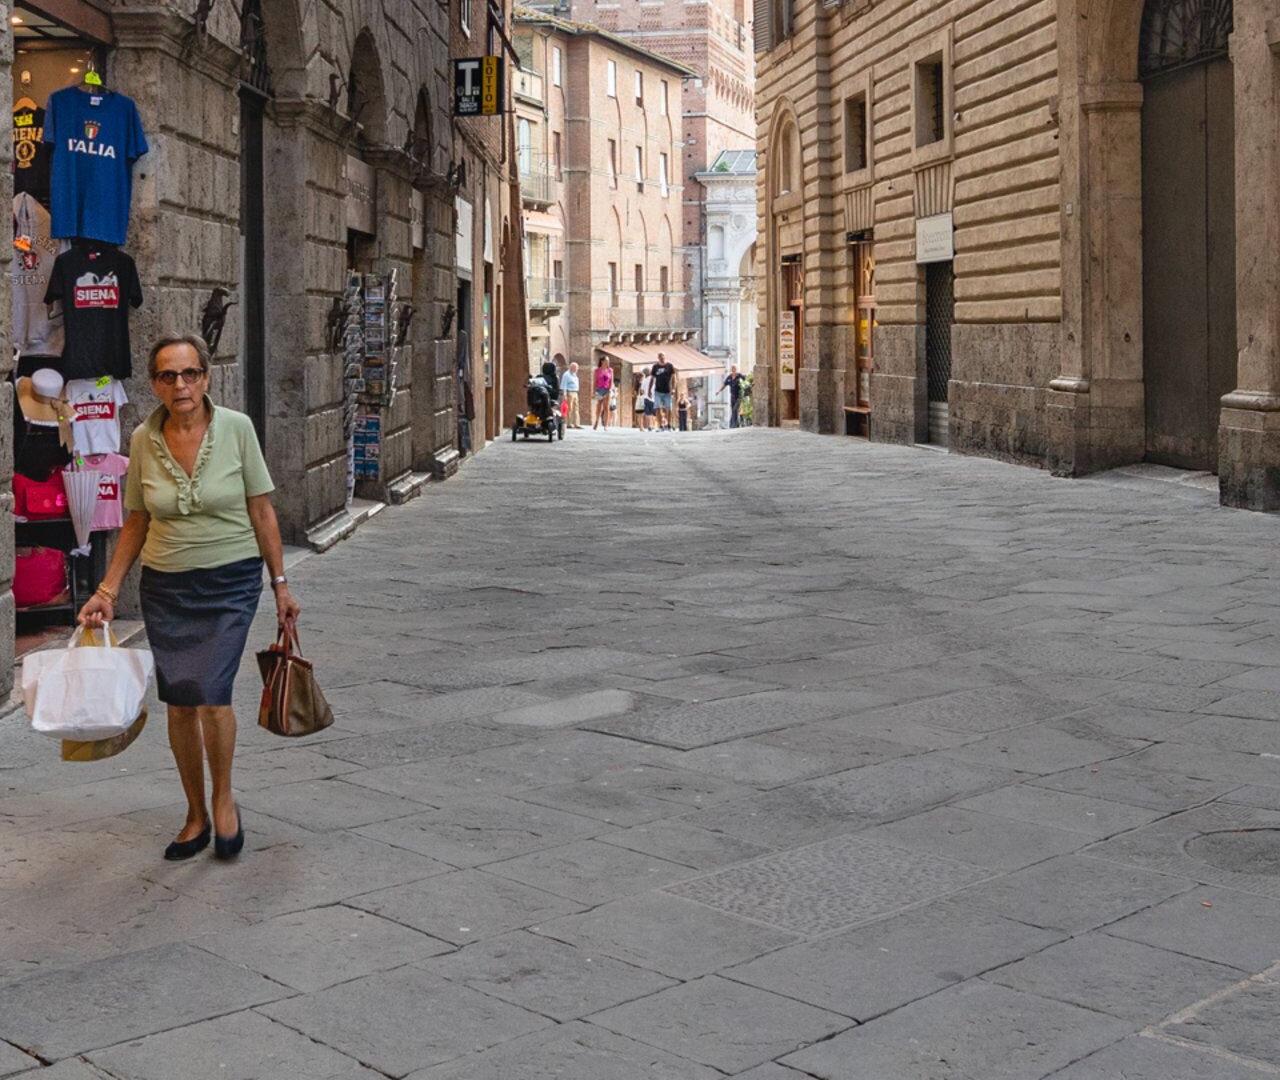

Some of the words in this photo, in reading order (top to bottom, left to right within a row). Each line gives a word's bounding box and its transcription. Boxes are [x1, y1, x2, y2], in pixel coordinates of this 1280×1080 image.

[458, 61, 479, 96] T
[485, 58, 494, 102] LOTTO
[76, 289, 117, 301] SIENA
[77, 404, 111, 416] SIENA
